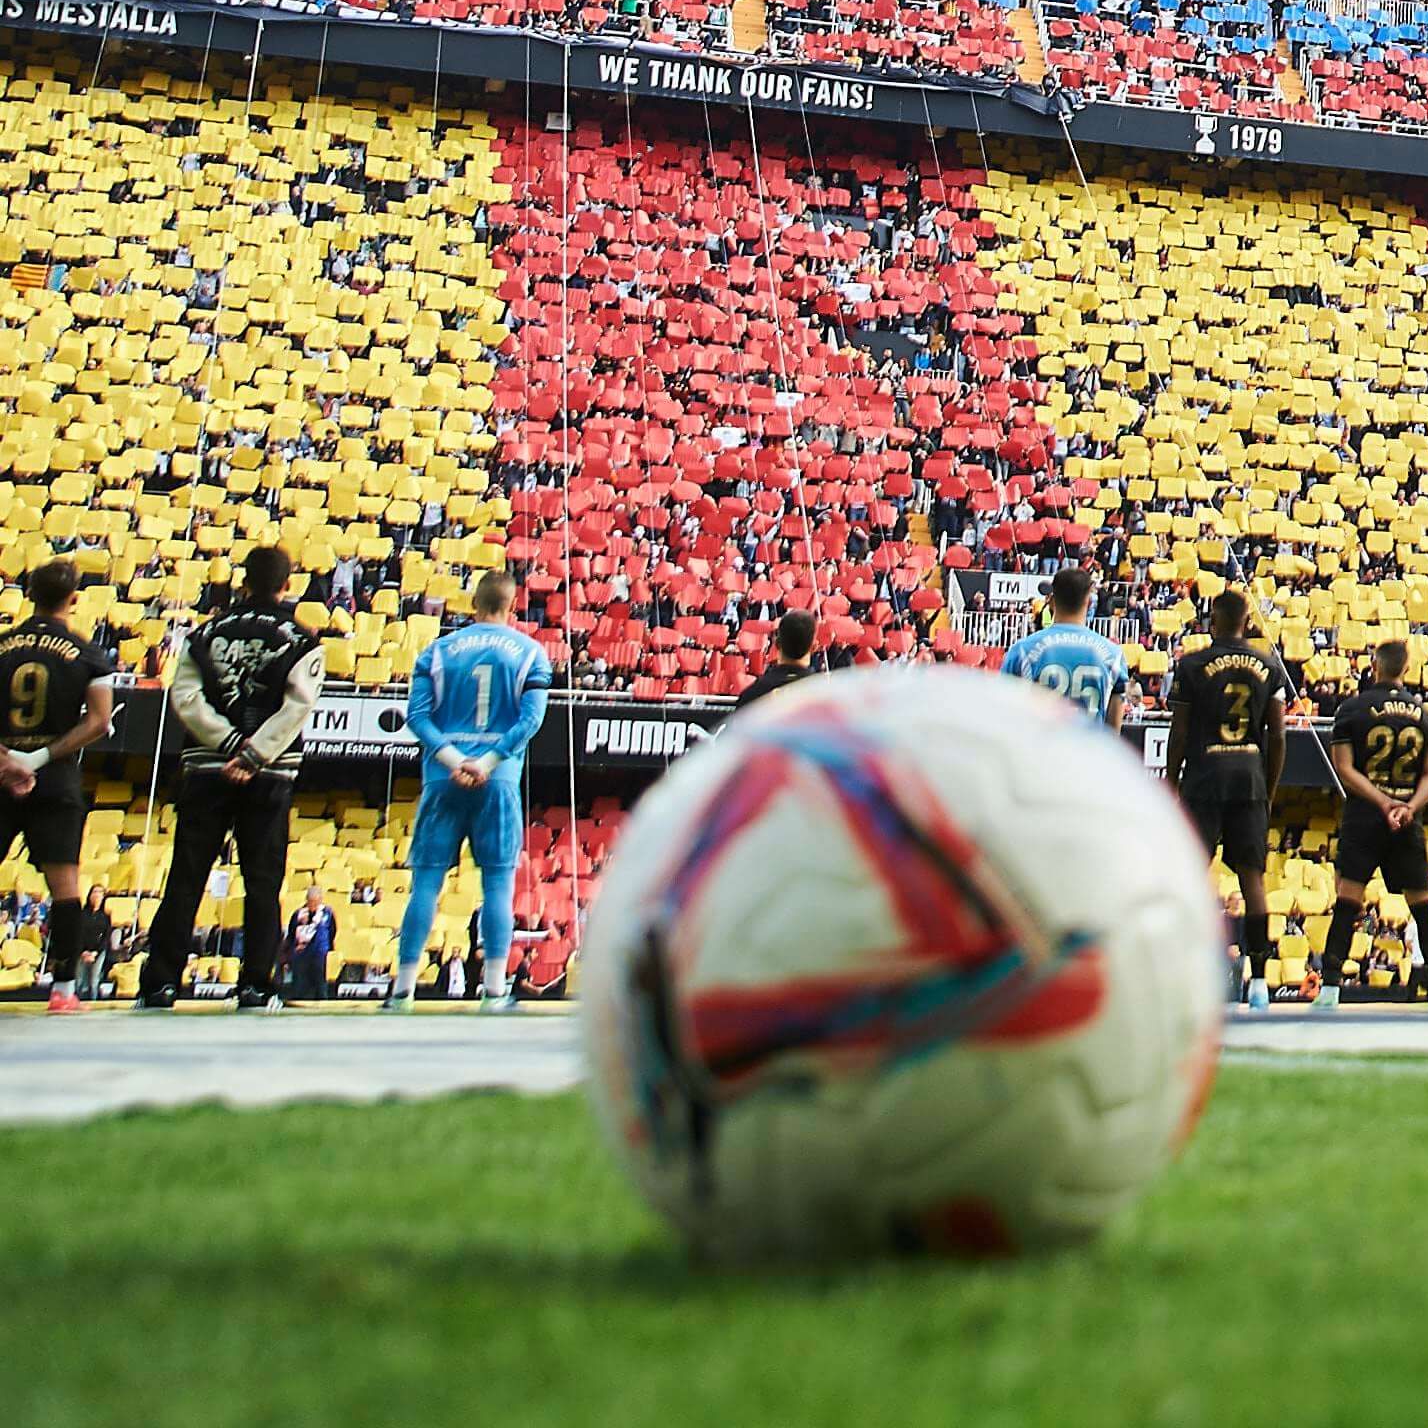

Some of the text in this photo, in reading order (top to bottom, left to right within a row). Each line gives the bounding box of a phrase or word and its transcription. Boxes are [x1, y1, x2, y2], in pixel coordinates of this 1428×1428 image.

[36, 0, 177, 36] MESTALLA
[599, 54, 874, 110] WE THANK OUR FANS!
[1229, 124, 1283, 154] 1979
[996, 580, 1020, 595] TM
[1204, 654, 1270, 683] MOSQUERA
[9, 661, 49, 729] 9
[472, 664, 494, 731] 1
[1220, 683, 1250, 742] 3
[312, 709, 349, 730] TM
[586, 719, 686, 756] PUMA
[382, 743, 420, 760] Group
[1367, 725, 1425, 782] 22
